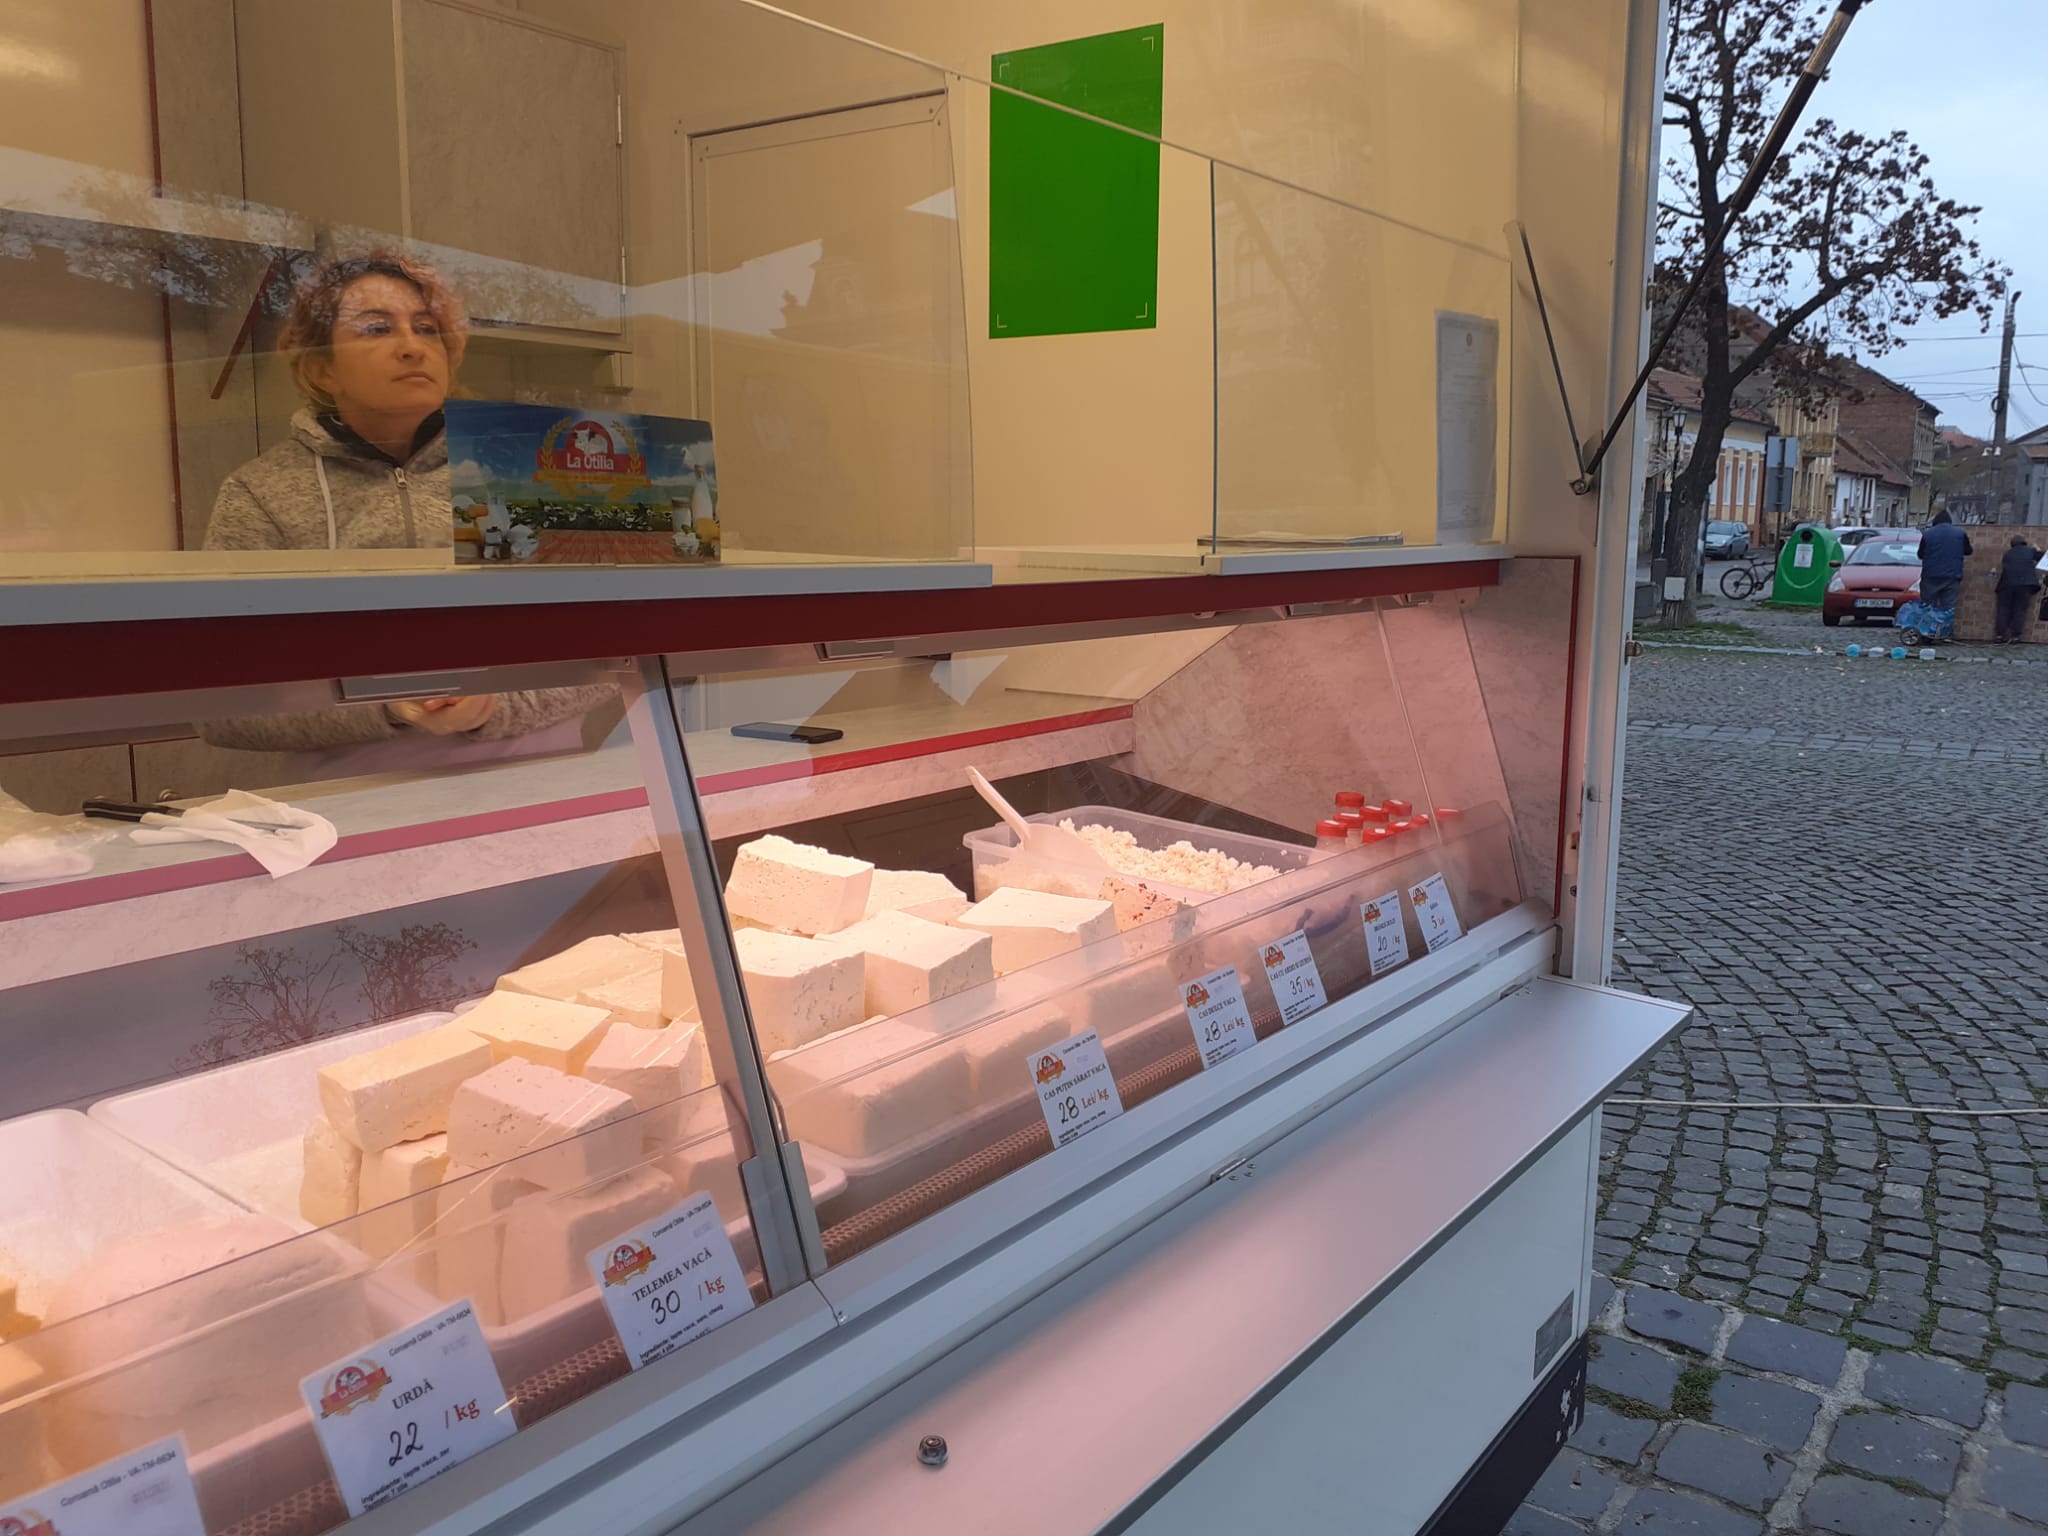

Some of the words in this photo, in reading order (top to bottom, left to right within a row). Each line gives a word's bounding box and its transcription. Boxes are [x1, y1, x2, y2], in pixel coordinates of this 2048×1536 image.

[567, 452, 581, 469] La
[584, 455, 614, 470] Otilia
[1431, 915, 1438, 929] 5
[1290, 975, 1303, 995] 35
[1205, 1020, 1221, 1043] 28
[1059, 1096, 1080, 1124] 28
[1097, 1088, 1110, 1101] kg
[632, 1267, 683, 1301] TELEMEA
[651, 1290, 681, 1325] 30
[704, 1275, 726, 1295] kg
[391, 1377, 434, 1410] URDĂ
[388, 1421, 424, 1467] 22
[453, 1397, 481, 1422] kg
